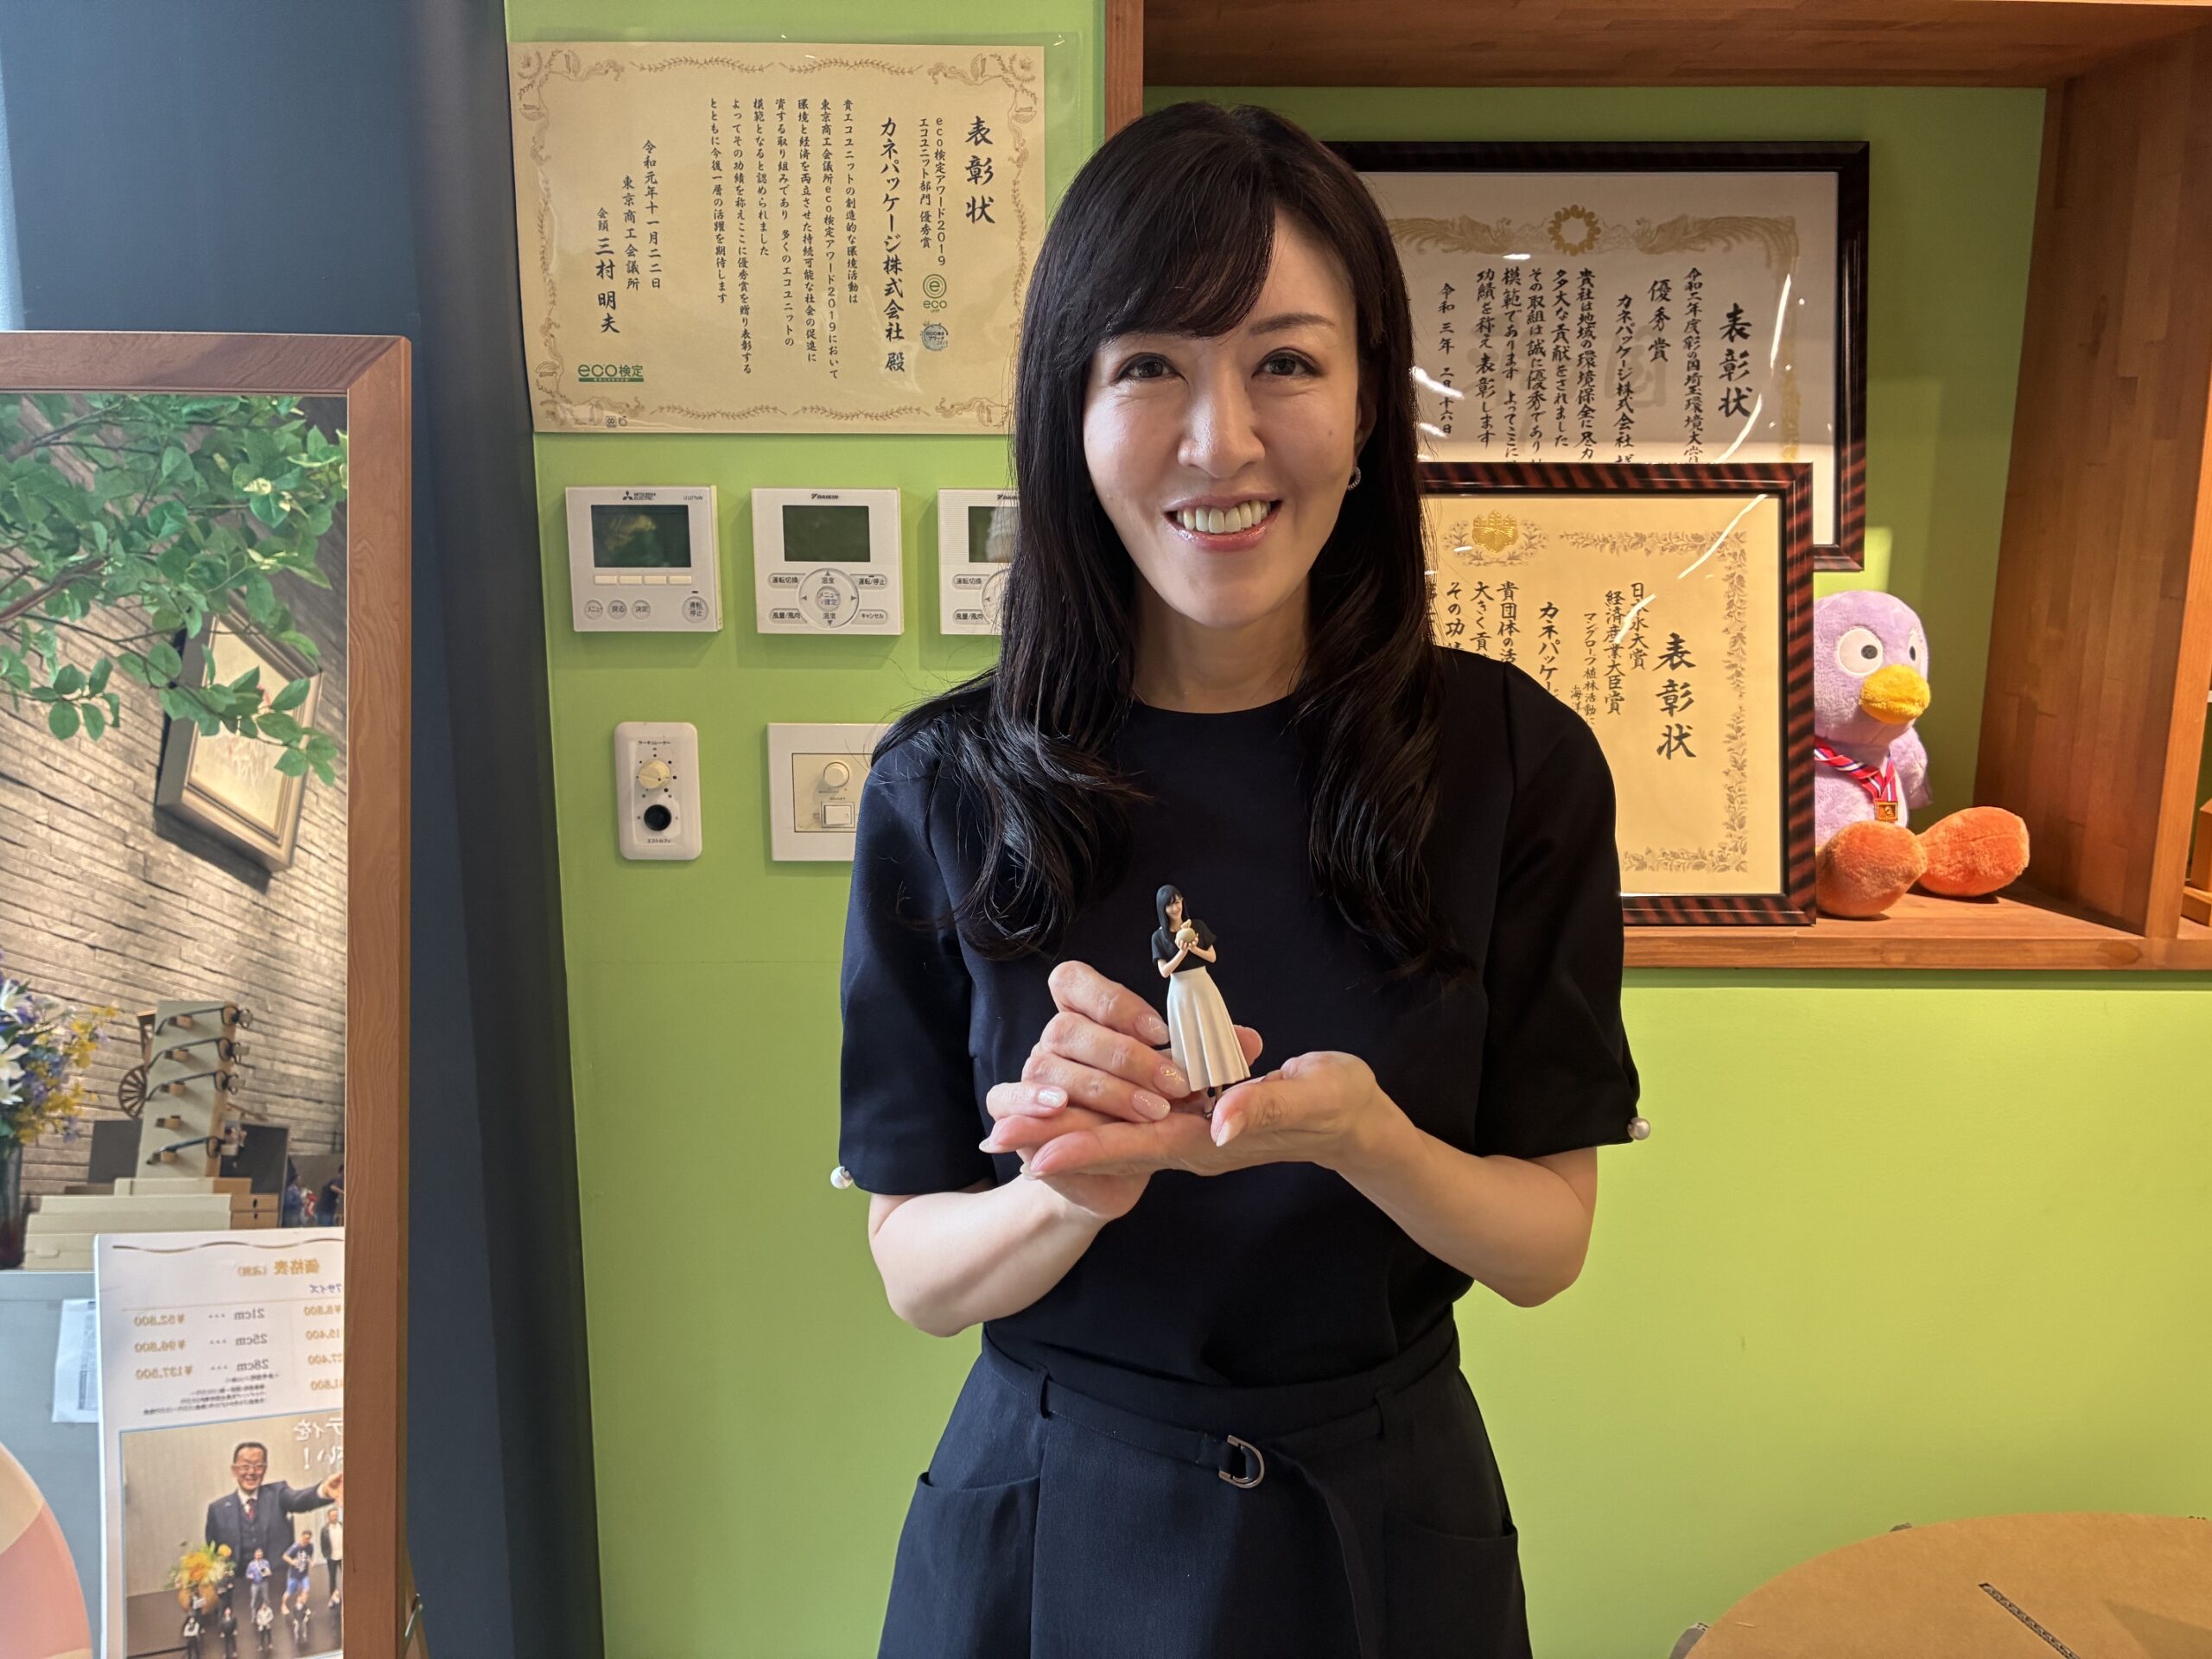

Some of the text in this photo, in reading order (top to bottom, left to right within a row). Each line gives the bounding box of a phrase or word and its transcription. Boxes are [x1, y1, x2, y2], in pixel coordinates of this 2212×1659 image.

[596, 207, 609, 232] 会頭
[621, 175, 640, 291] 東京商工会議所
[710, 98, 728, 304] とともに今後一層の活躍を期待します
[753, 98, 769, 257] 模範となると認められました
[775, 98, 794, 346] 資する取り組みであり 多くのエコユニットの
[918, 118, 932, 249] エコユニット部門 優秀賞
[964, 115, 995, 225] 表彰状
[880, 117, 906, 372] カネパッケージ株式会社 殿
[923, 300, 948, 308] eco
[577, 364, 644, 378] eco検定
[1501, 266, 1522, 381] 模範であります
[1526, 268, 1548, 454] その取組は誠に優秀であり
[1551, 269, 1573, 448] 多大な貢献をされました
[1573, 268, 1597, 461] 貴社は地域の環境保全に尽力
[1613, 294, 1636, 448] カネパッケージ株式会社
[1647, 278, 1673, 362] 優秀賞
[1718, 302, 1753, 418] 表彰状
[1470, 581, 1495, 658] 大きく貢
[1603, 590, 1625, 715] 経済産業大臣賞
[1652, 632, 1697, 760] 表彰状
